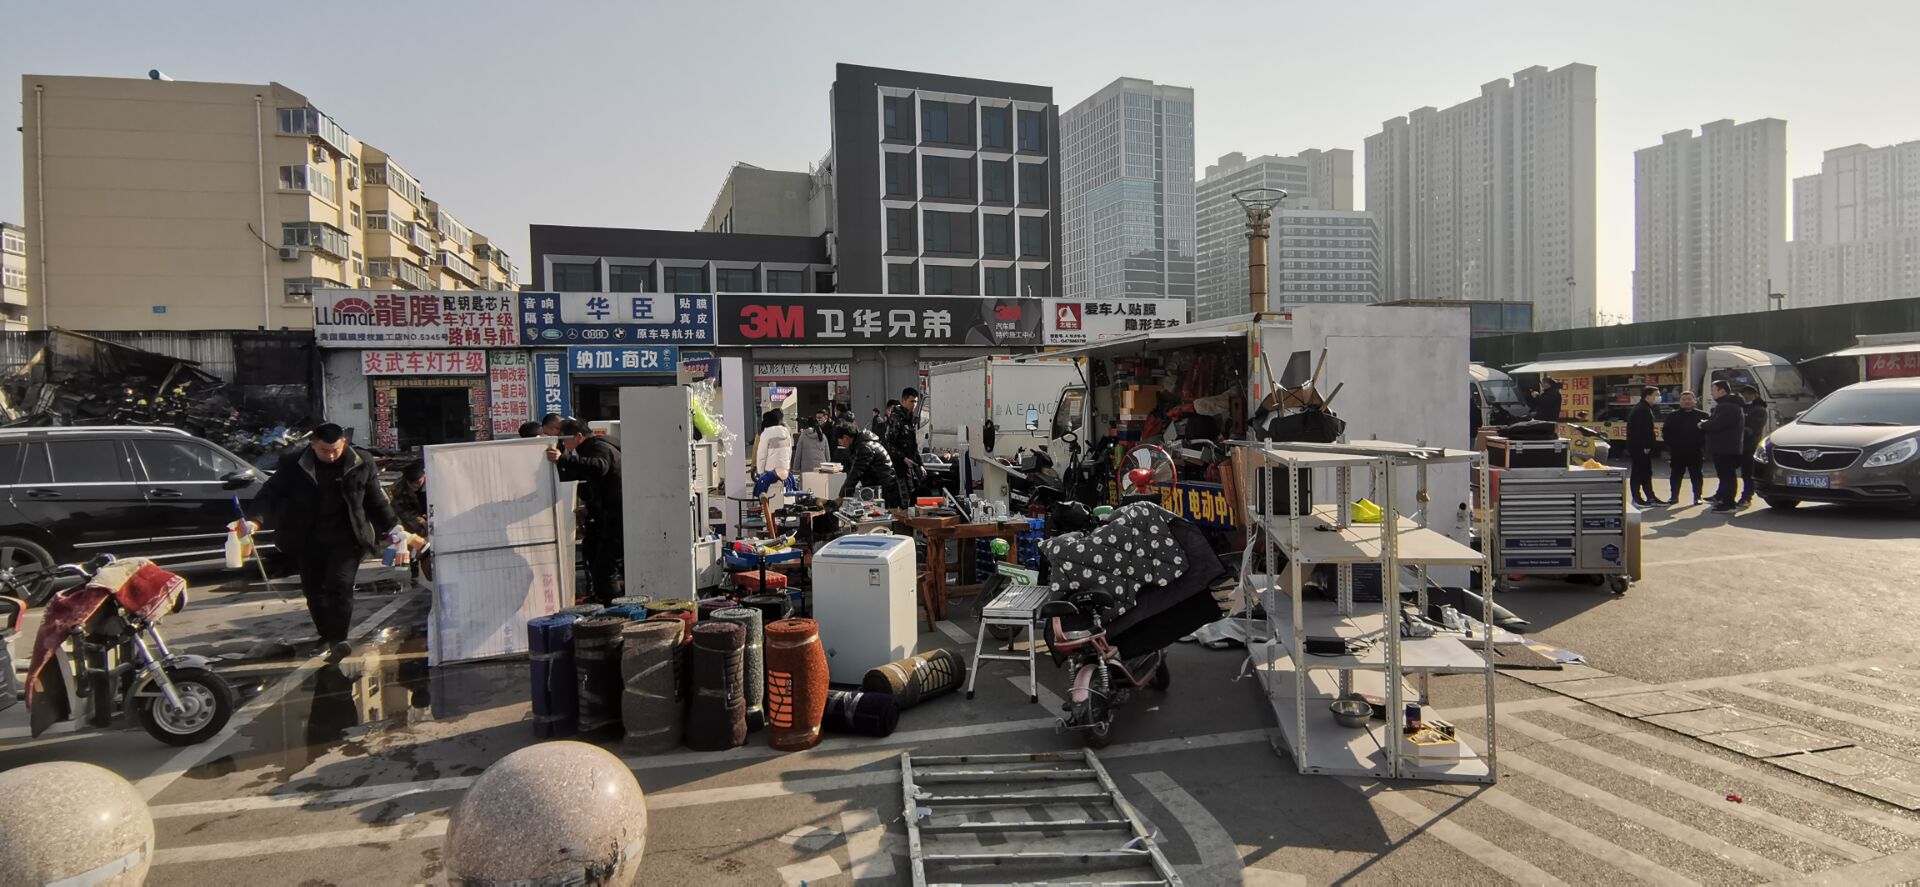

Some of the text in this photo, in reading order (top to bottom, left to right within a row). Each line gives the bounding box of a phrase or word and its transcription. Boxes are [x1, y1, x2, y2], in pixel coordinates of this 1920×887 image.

[374, 294, 441, 327] 龍膜
[443, 296, 511, 312] 配钥匙芯片
[524, 298, 554, 309] 音响
[586, 297, 654, 320] 华臣
[680, 298, 707, 309] 贴膜
[1085, 303, 1157, 316] 爱车人贴膜
[316, 307, 375, 325] LLumar
[443, 312, 513, 327] 车灯升级
[525, 313, 555, 324] 隔音
[680, 313, 707, 324] 真皮
[995, 305, 1022, 321] 3M
[739, 304, 951, 338] 3M 卫华兄弟
[1125, 318, 1180, 331] 隐形车衣
[449, 327, 515, 345] 路畅导航
[636, 328, 706, 340] 原车导航升级
[364, 352, 484, 373] 炎武车灯升级
[490, 351, 526, 365] 炫艺店
[491, 368, 527, 382] 音响改装
[493, 384, 527, 398] 一键启动
[493, 401, 528, 416] 全车隔音
[1188, 488, 1235, 526] 电动中
